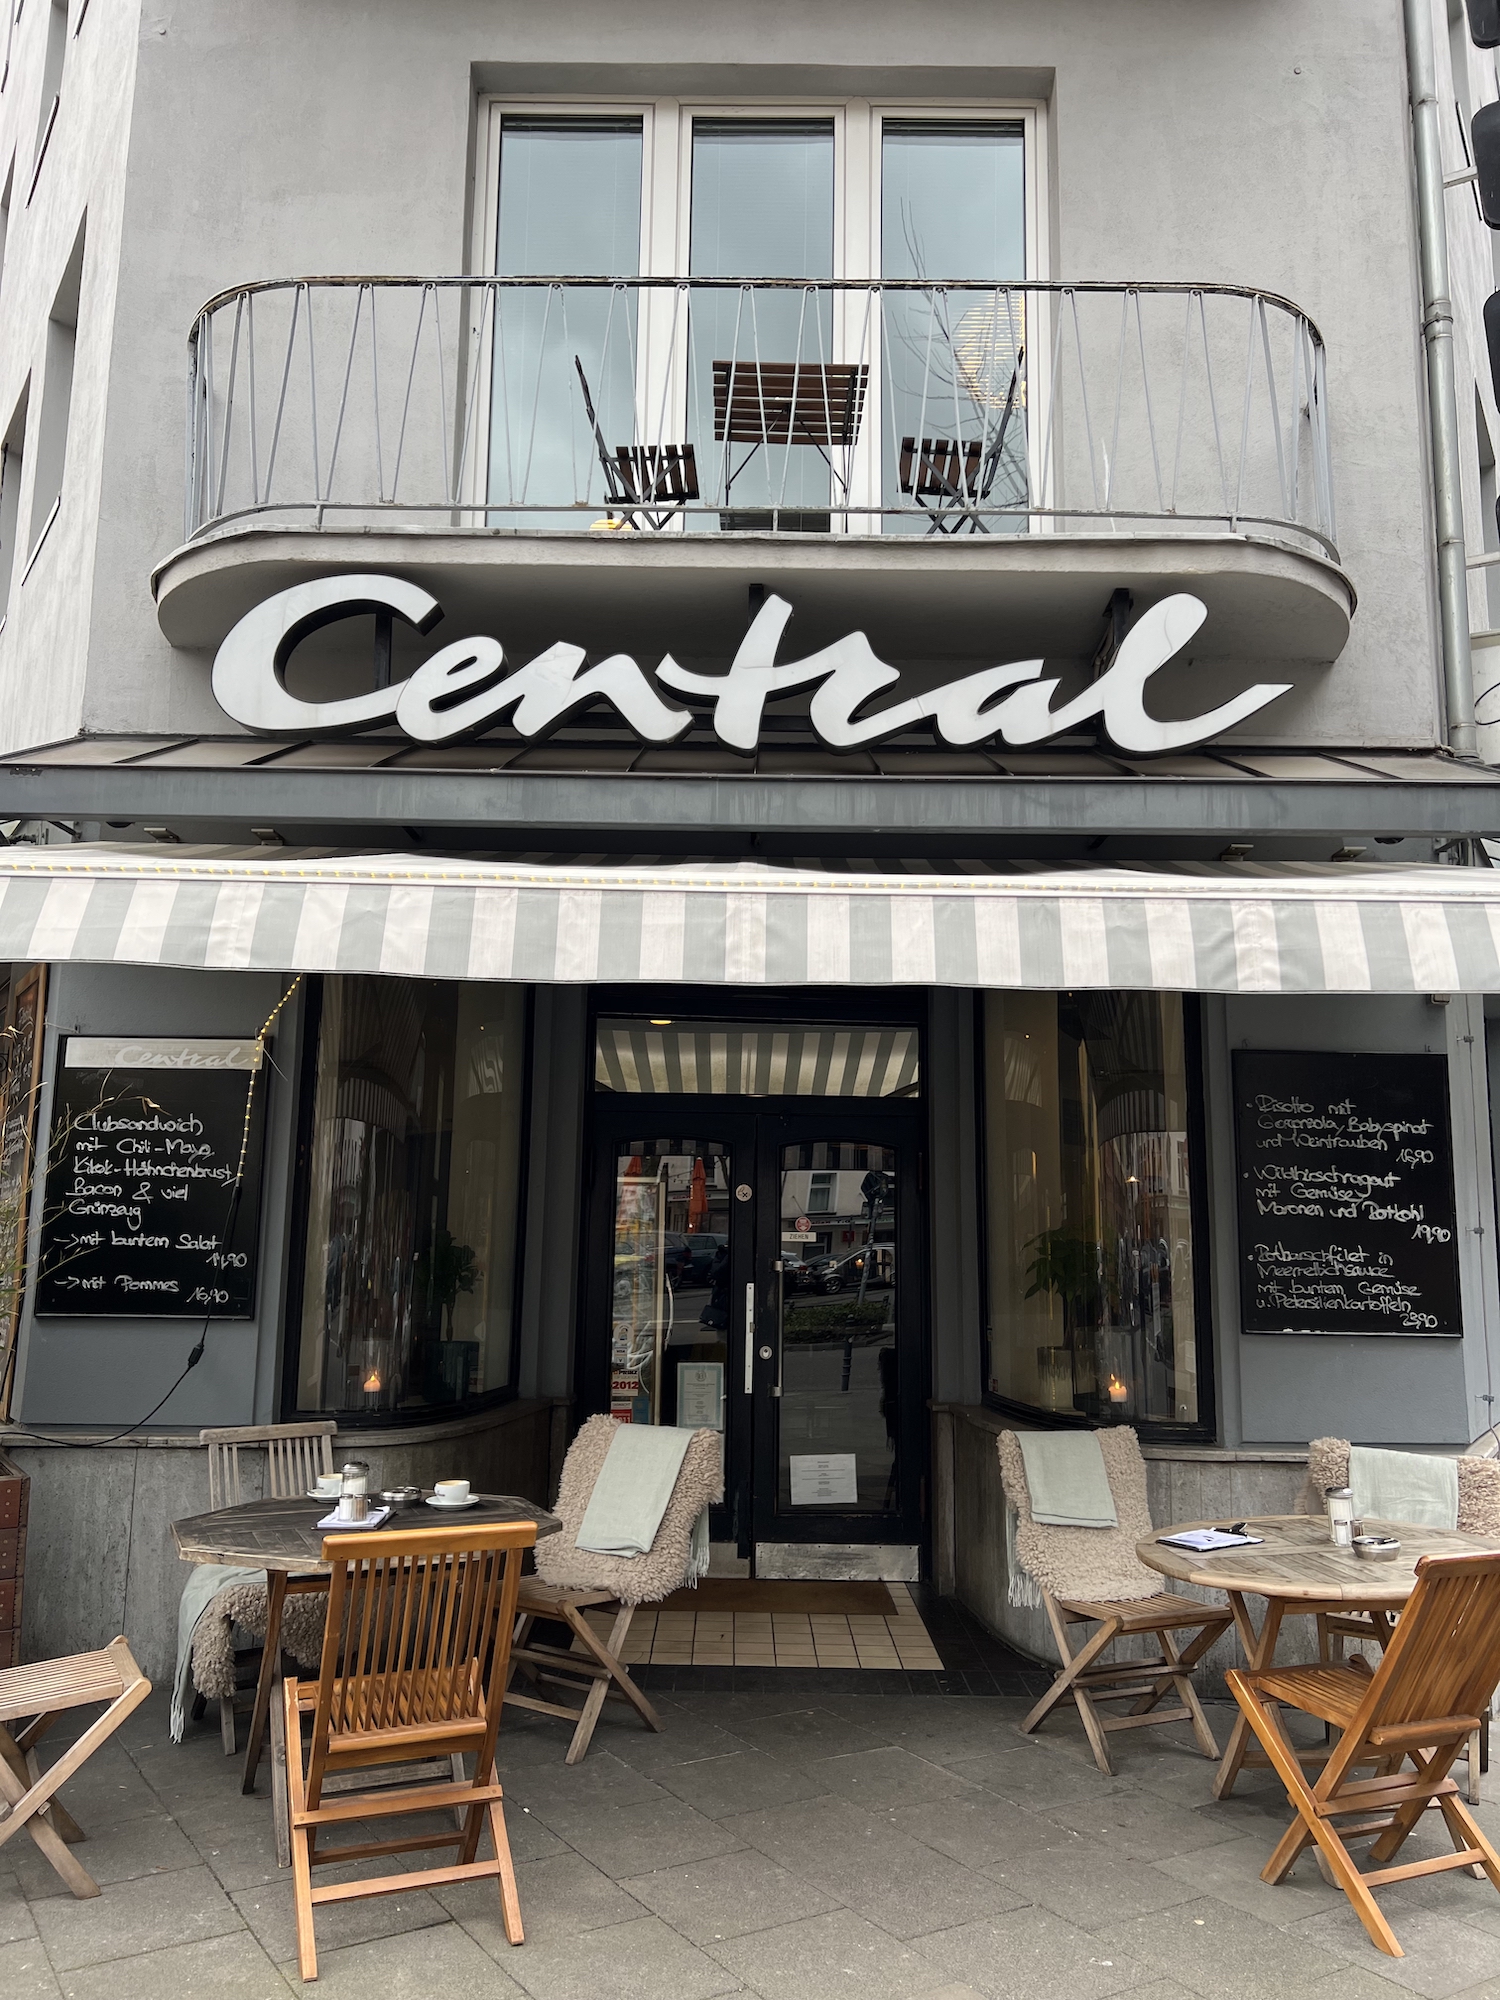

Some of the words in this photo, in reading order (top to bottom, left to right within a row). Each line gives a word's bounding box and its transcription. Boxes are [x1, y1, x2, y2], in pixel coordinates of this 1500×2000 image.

[211, 573, 1293, 755] Central
[114, 1045, 249, 1068] Central
[1327, 1098, 1357, 1115] mit
[74, 1112, 204, 1137] Clubsandwich
[1347, 1116, 1434, 1142] Babyspinat
[76, 1137, 108, 1151] mit
[1256, 1133, 1281, 1149] und
[65, 1177, 122, 1197] Bacon
[132, 1181, 154, 1204] &
[161, 1183, 189, 1201] viel
[1256, 1183, 1281, 1198] mit
[69, 1199, 142, 1231] Grünzeug
[1257, 1200, 1324, 1217] Maronen
[1330, 1204, 1358, 1218] und
[1362, 1201, 1425, 1222] Rotkohl
[80, 1231, 106, 1246] mit
[111, 1230, 170, 1249] buntem
[175, 1233, 223, 1250] Salat
[1411, 1224, 1451, 1244] 19,90
[1379, 1252, 1394, 1266] in
[82, 1275, 107, 1290] mit
[114, 1274, 180, 1293] Pommes
[1257, 1281, 1284, 1294] mit
[1289, 1280, 1345, 1295] buntem
[1358, 1281, 1422, 1297] Gemüse
[612, 1381, 639, 1390] 2012
